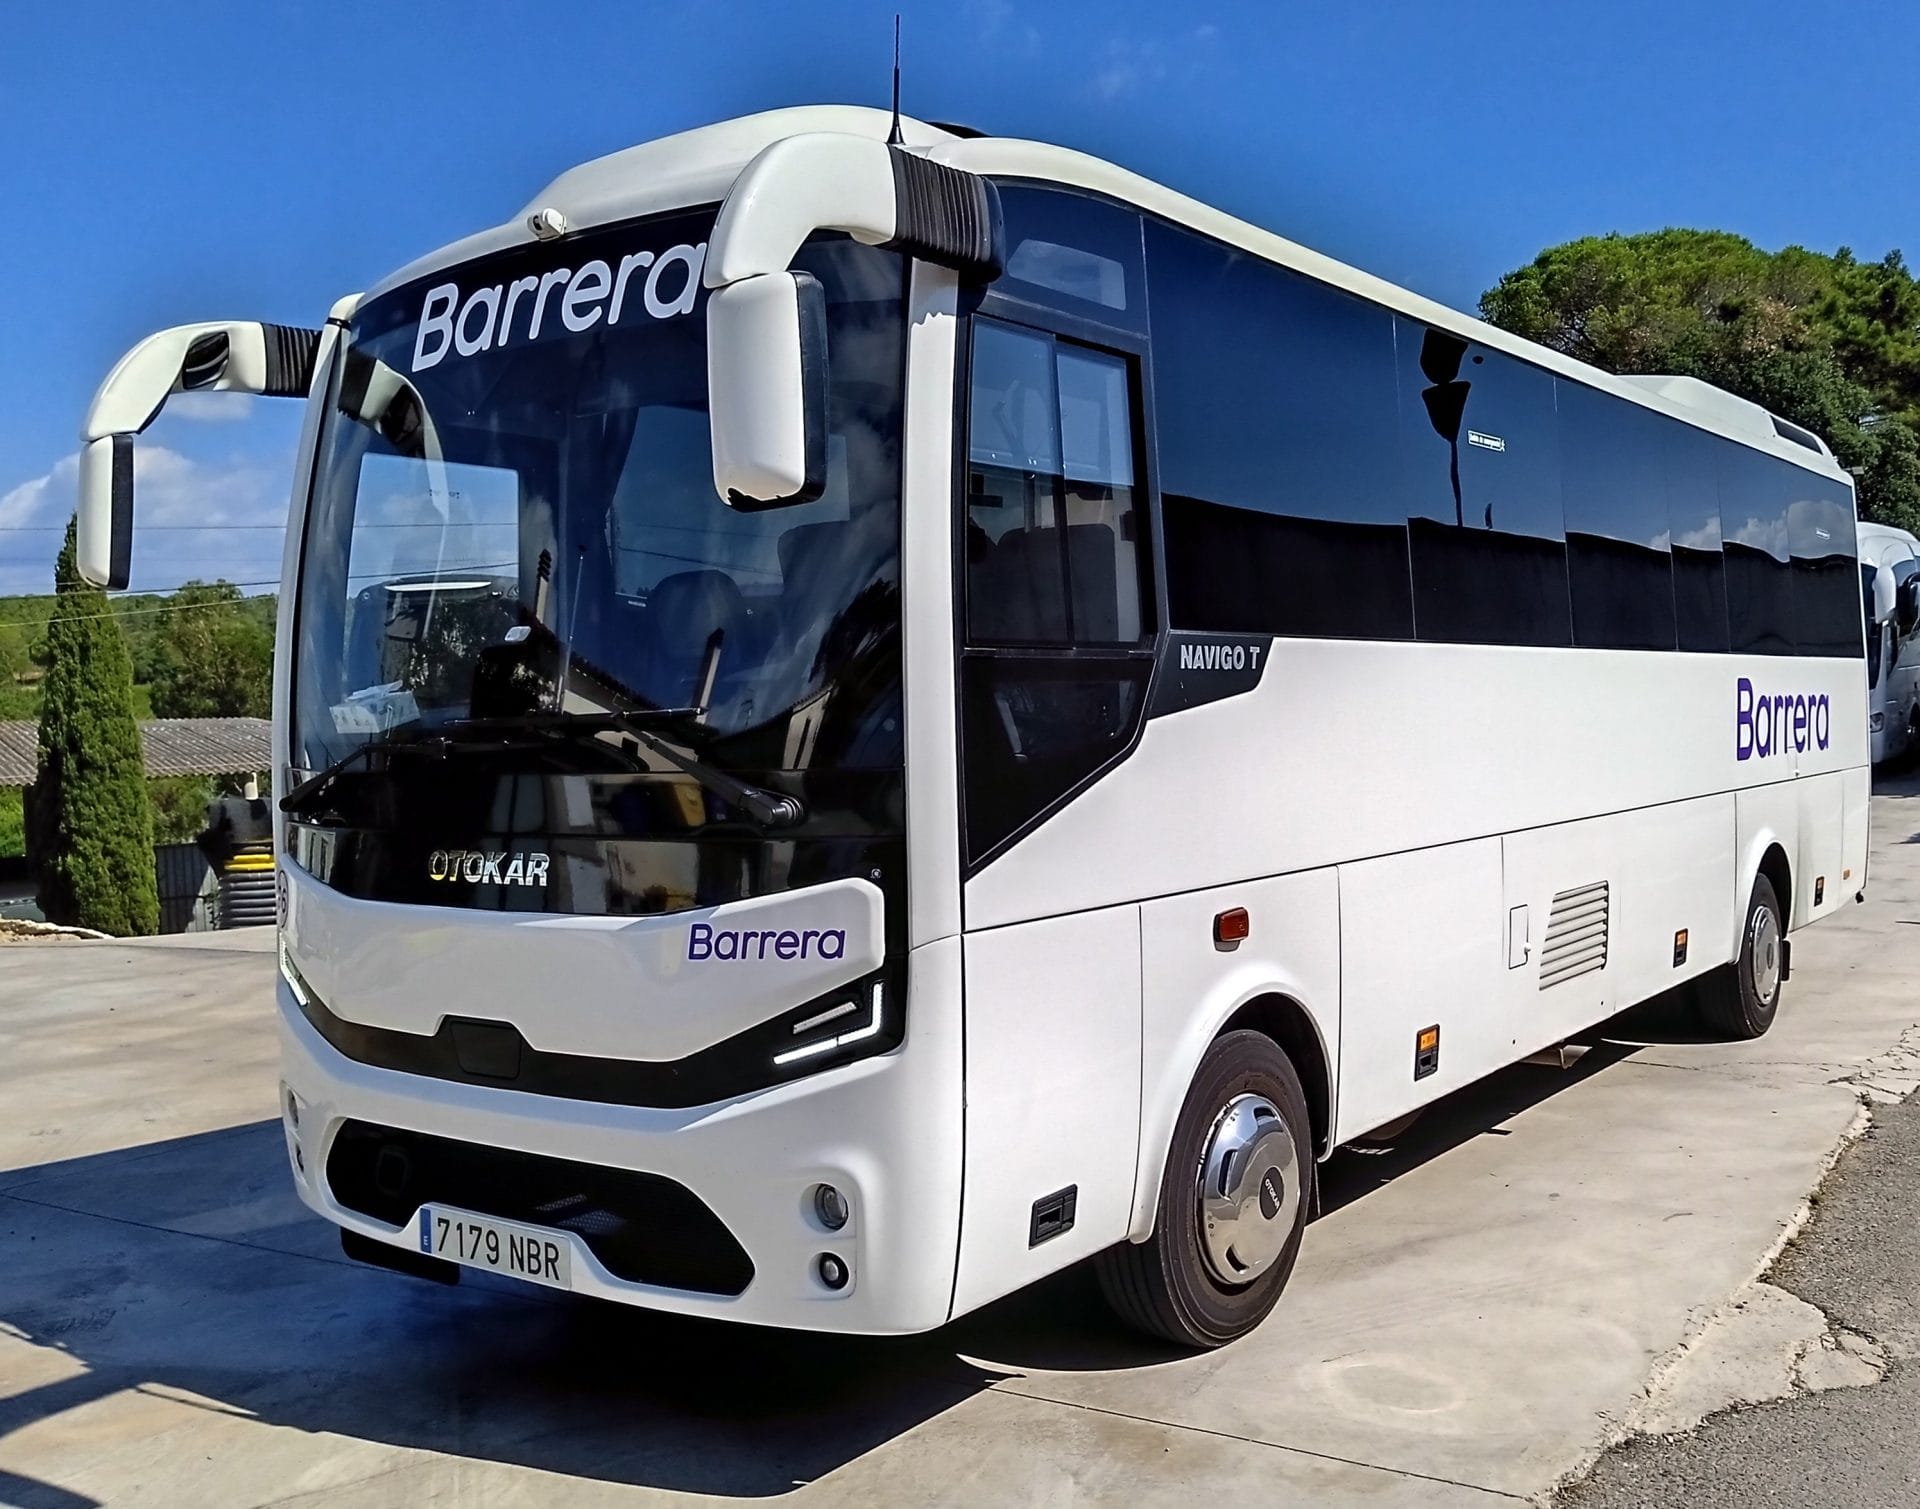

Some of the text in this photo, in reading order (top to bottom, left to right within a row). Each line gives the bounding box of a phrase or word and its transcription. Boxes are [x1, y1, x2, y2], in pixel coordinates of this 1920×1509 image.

[411, 242, 707, 373] Barrera
[1180, 644, 1260, 670] NAVIGO T
[1736, 677, 1829, 761] Barrera
[428, 849, 550, 887] OTOKAR
[688, 923, 846, 960] Barrera
[437, 1217, 560, 1281] 7179 NBR
